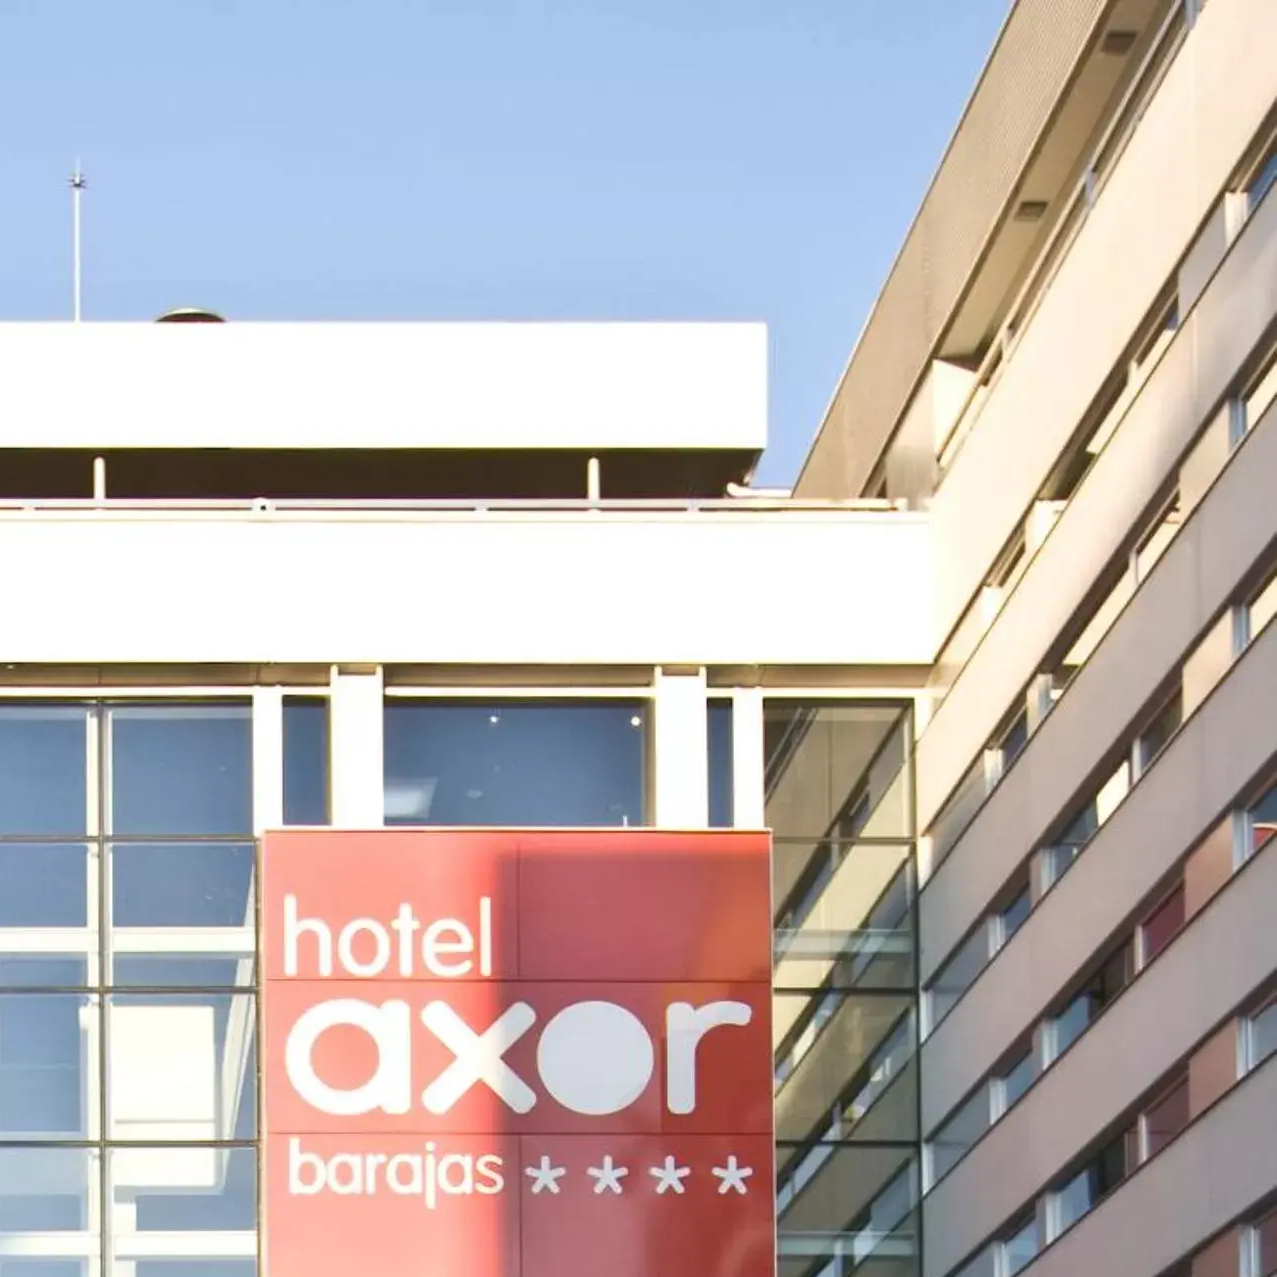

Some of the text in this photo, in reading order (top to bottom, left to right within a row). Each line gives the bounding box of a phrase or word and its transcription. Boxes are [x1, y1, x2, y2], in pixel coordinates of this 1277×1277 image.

[284, 894, 491, 977] hotel
[285, 998, 752, 1115] axor
[289, 1137, 504, 1209] barajas
